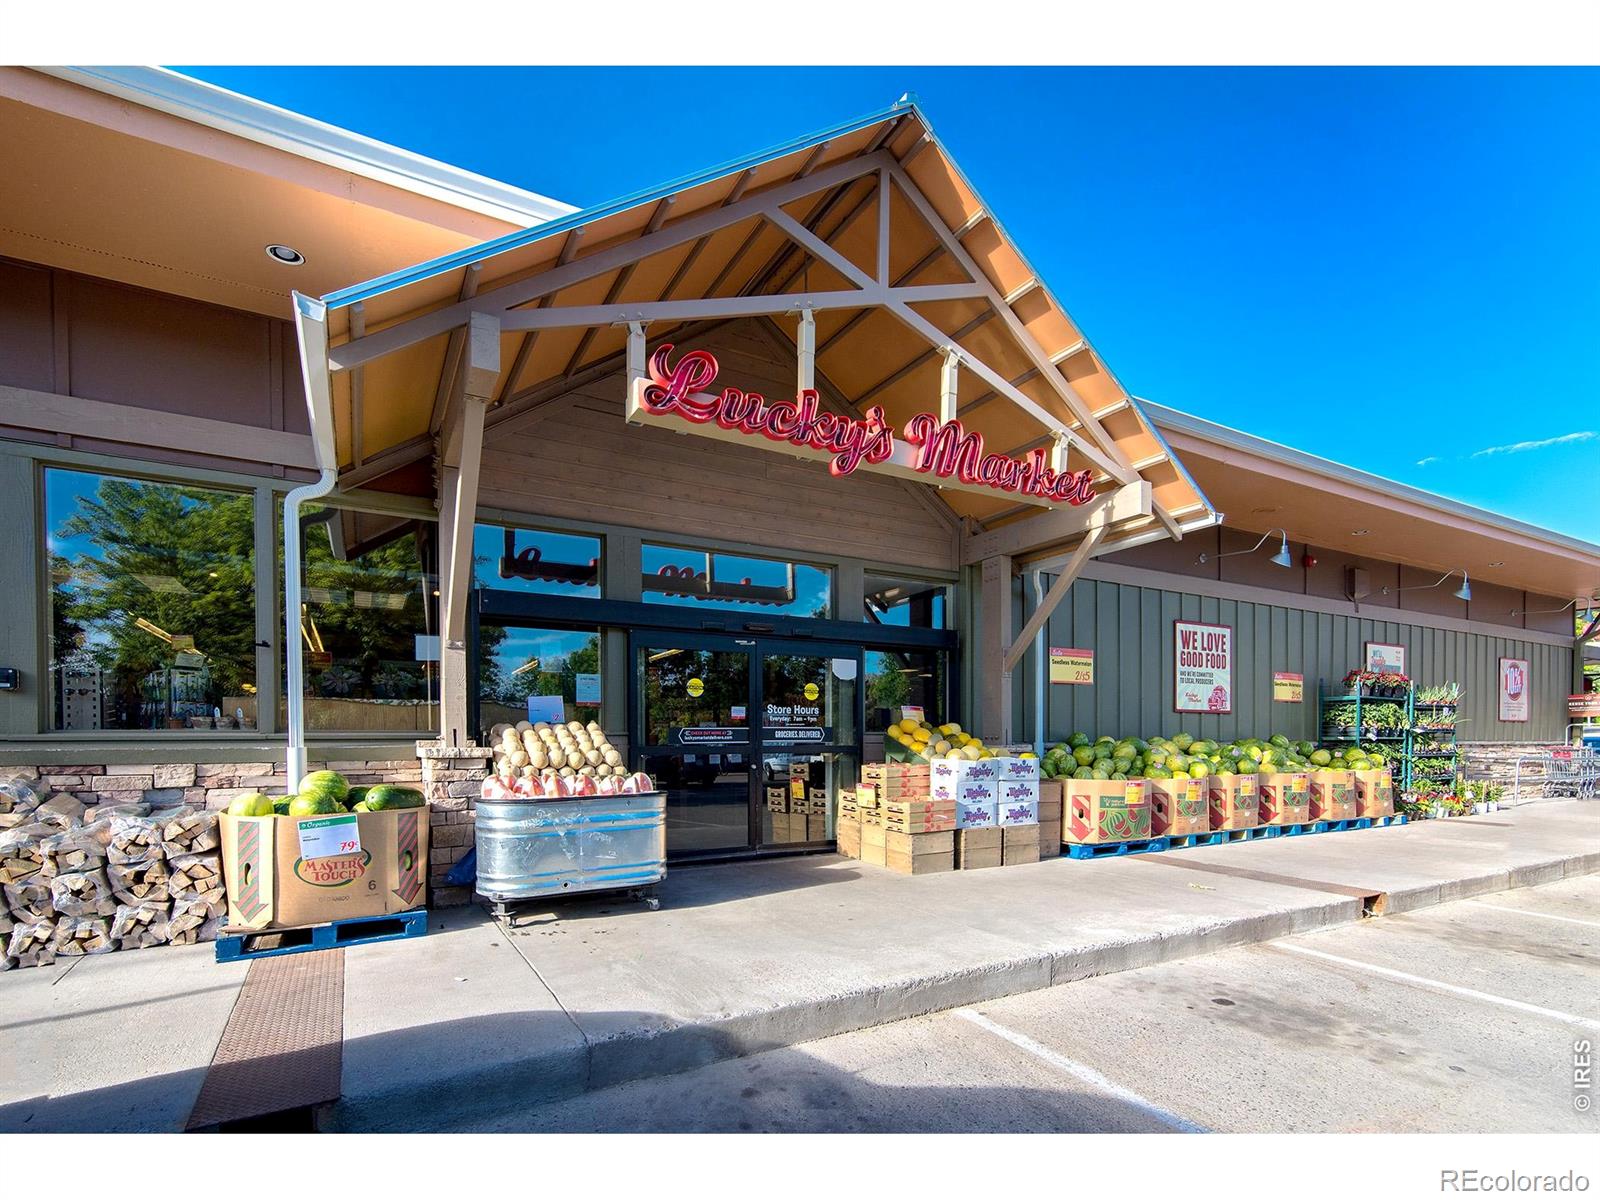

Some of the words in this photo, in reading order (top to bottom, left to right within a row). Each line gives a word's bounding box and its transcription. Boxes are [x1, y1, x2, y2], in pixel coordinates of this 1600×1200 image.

[639, 343, 894, 476] Lucky's
[904, 413, 1096, 505] Market
[1180, 630, 1198, 650] WE
[1201, 631, 1227, 653] LOVE
[1180, 650, 1204, 667] GOOD
[1206, 652, 1227, 670] FOOD
[767, 704, 792, 714] Store
[794, 704, 820, 715] Hours
[770, 715, 791, 723] Everyday:
[306, 820, 331, 828] Organic
[312, 870, 357, 882] TOUCH
[368, 879, 377, 891] 6
